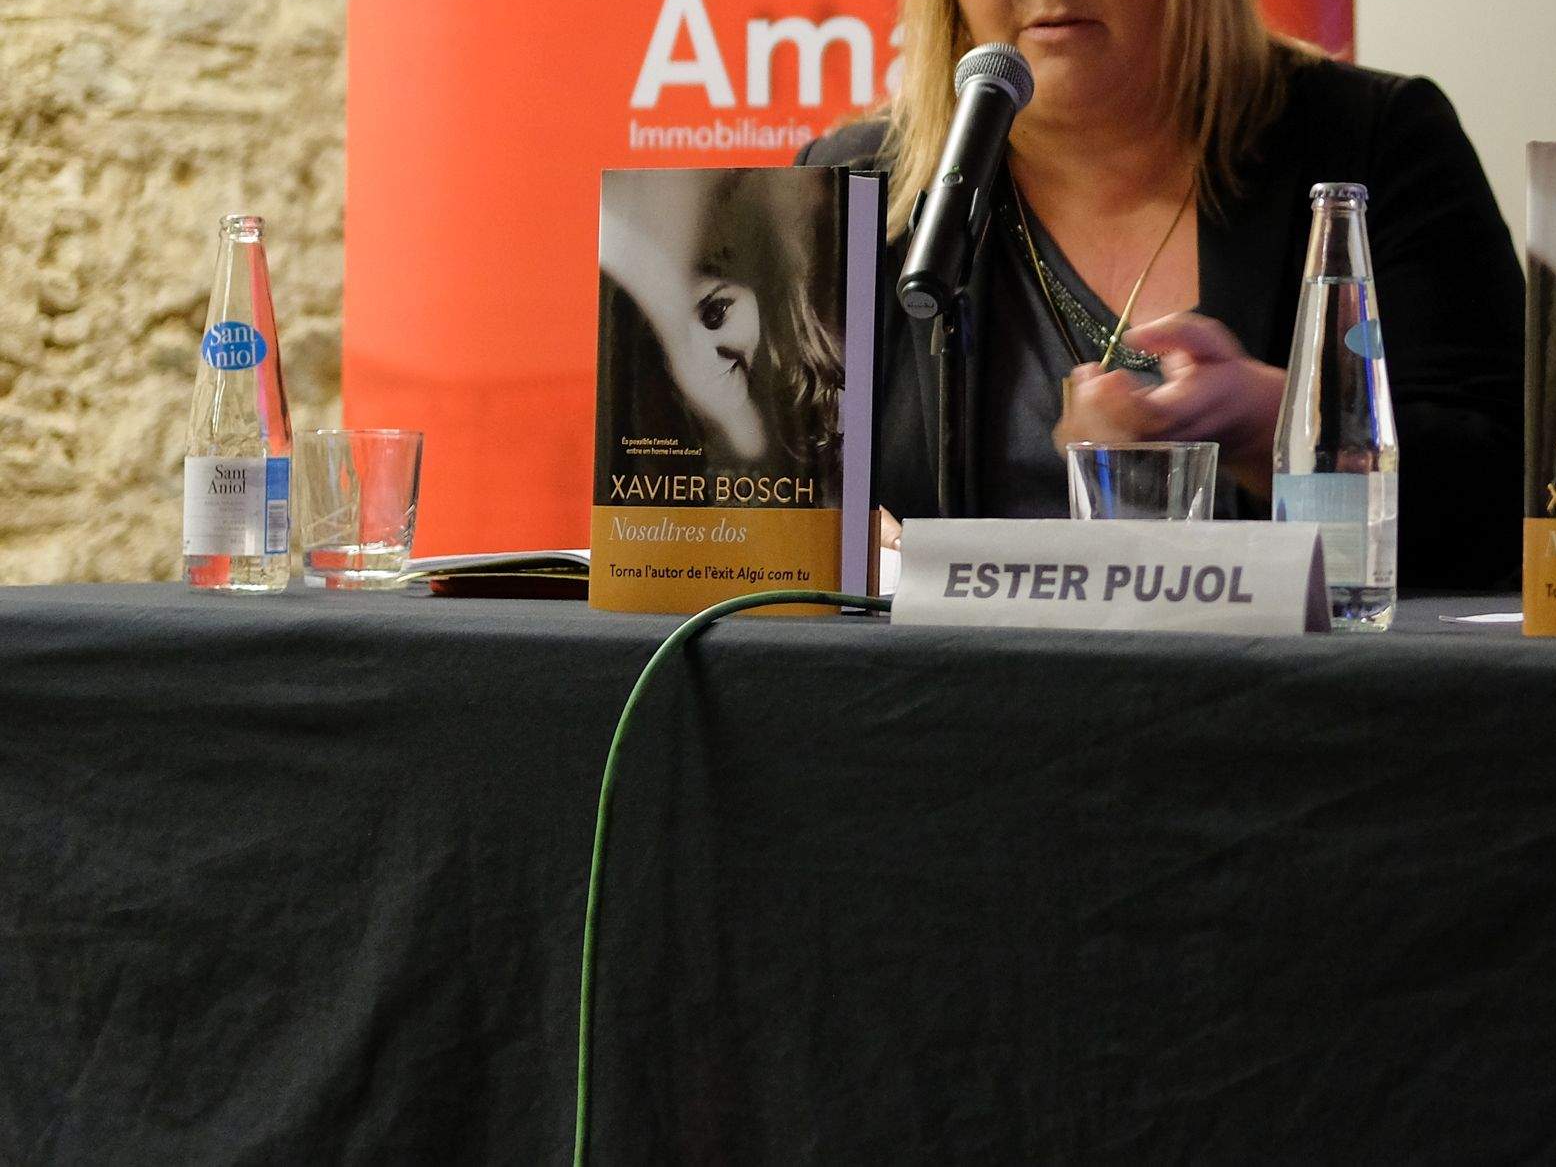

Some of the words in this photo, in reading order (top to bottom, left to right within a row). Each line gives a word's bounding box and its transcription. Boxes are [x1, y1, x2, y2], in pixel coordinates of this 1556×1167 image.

[215, 463, 247, 480] Sant
[208, 479, 246, 494] Aniol
[610, 474, 706, 501] XAVIER
[715, 476, 814, 504] BOSCH
[609, 517, 705, 543] Nosaltres
[711, 519, 747, 543] dos
[610, 564, 642, 578] Torna
[687, 566, 701, 579] de
[737, 567, 764, 583] Algú
[767, 570, 793, 581] com
[797, 569, 810, 581] tu
[943, 562, 1089, 601] ESTER
[1102, 565, 1253, 604] PUJOL
